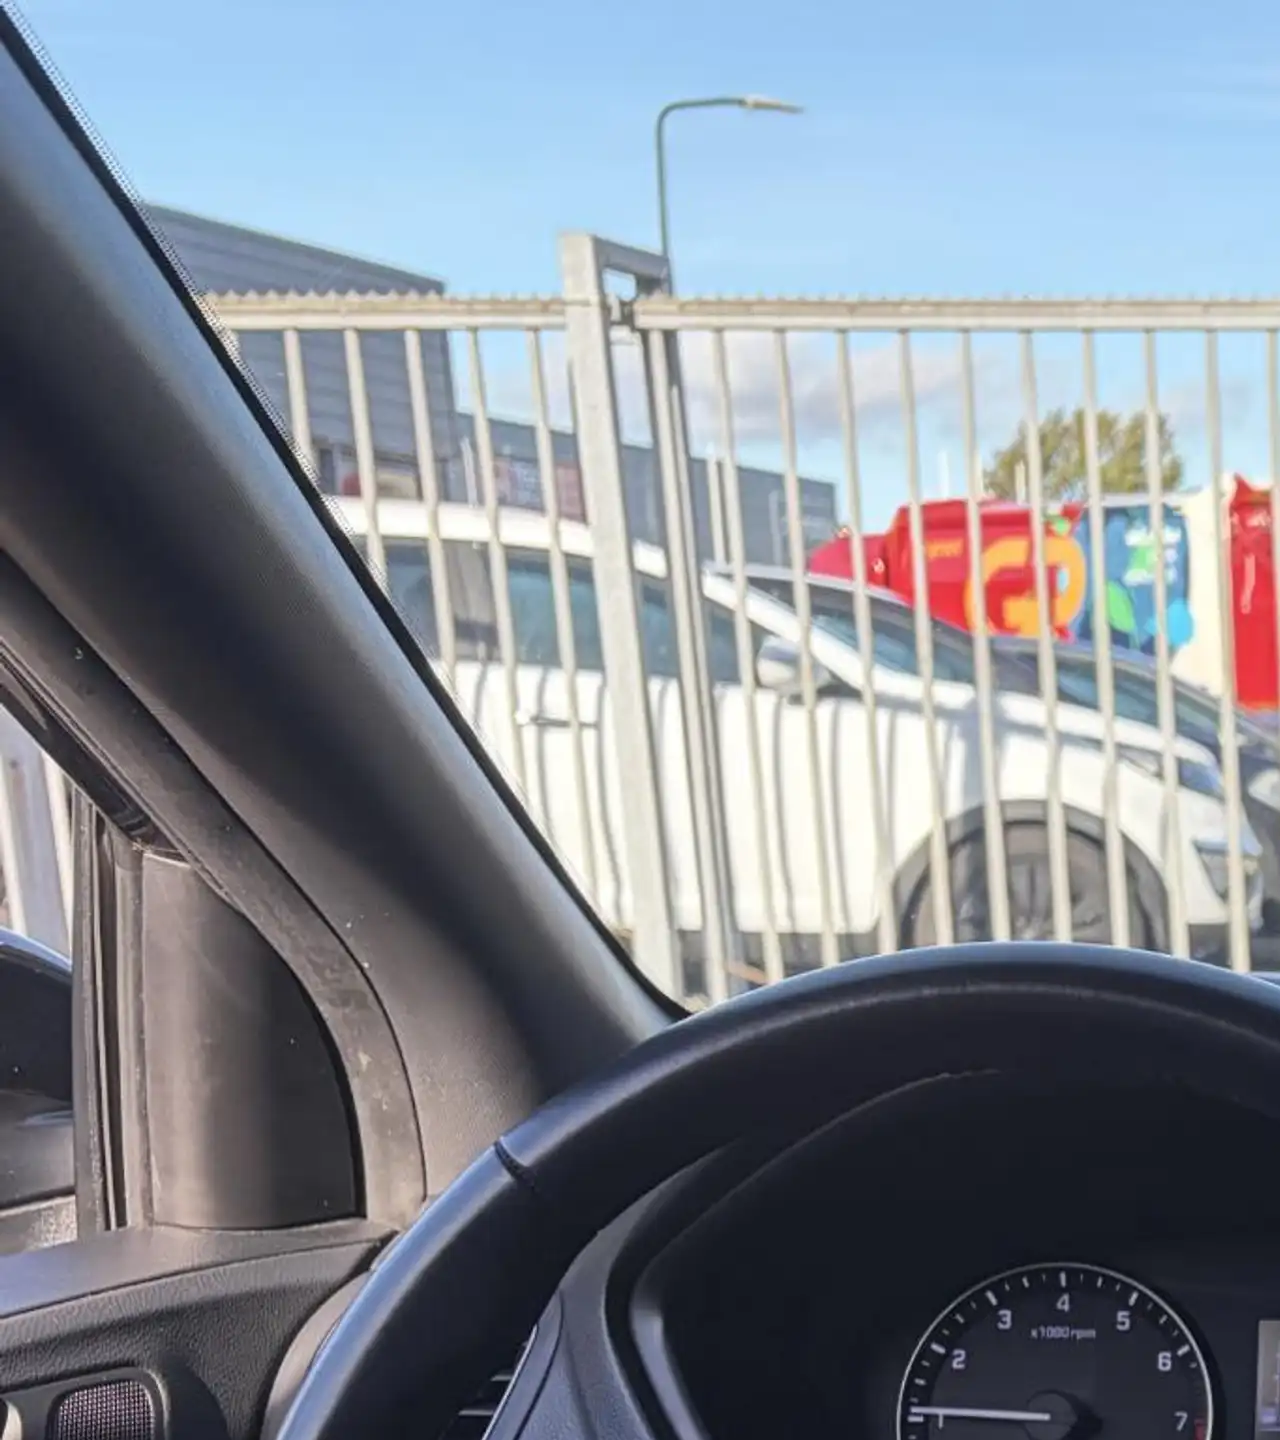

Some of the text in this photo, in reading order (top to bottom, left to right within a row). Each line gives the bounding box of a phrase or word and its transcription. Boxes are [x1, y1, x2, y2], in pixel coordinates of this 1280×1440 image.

[1057, 1293, 1070, 1312] 4
[998, 1309, 1012, 1329] 3
[1116, 1310, 1131, 1331] 5
[951, 1350, 966, 1370] 2
[1157, 1352, 1172, 1371] 6
[1174, 1411, 1188, 1431] 7
